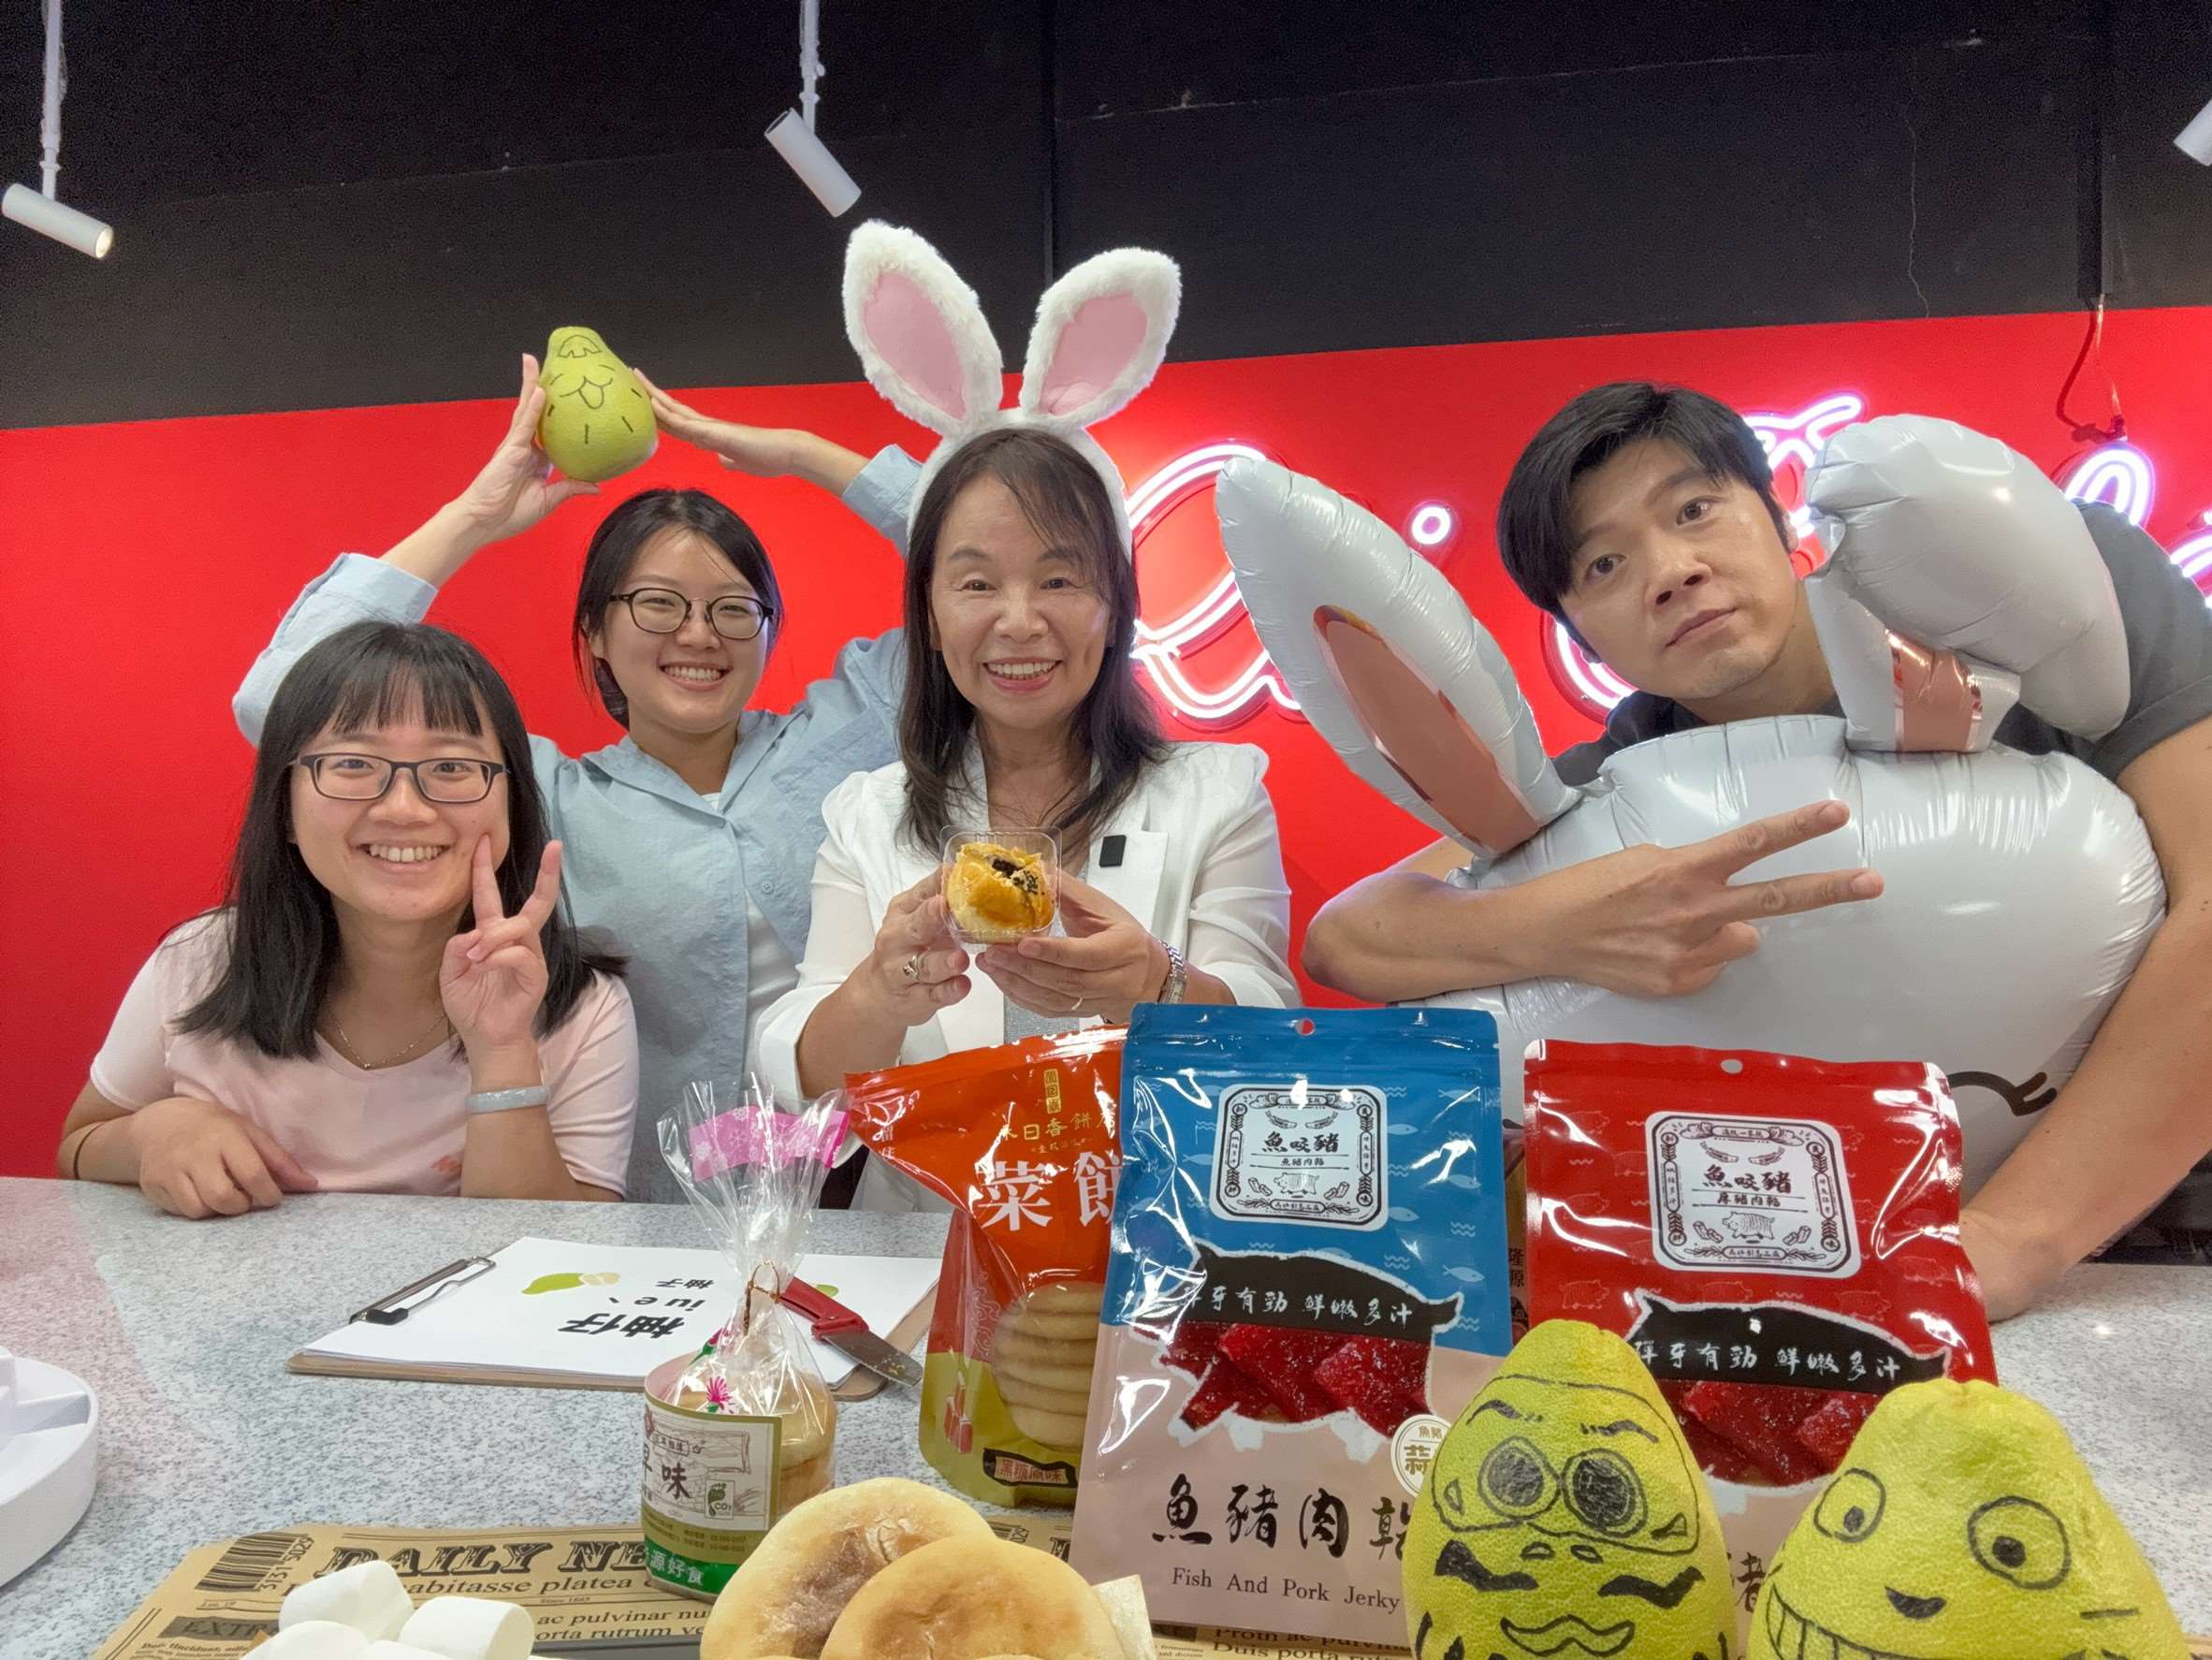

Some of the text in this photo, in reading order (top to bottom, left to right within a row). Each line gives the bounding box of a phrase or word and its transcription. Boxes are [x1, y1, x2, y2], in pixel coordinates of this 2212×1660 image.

[1261, 1130, 1340, 1153] 魚咬豬
[1702, 1164, 1791, 1194] 魚咬豬
[558, 1313, 685, 1338] 柚仔
[1404, 1444, 1431, 1476] 蒜
[313, 1541, 646, 1580] DAILY NE
[403, 1579, 530, 1594] abitasse
[540, 1578, 633, 1595] platea
[1171, 1567, 1401, 1614] Fish And Pork Jerky
[183, 1620, 278, 1638] EXTR
[537, 1610, 709, 1626] ac pulvinar nu
[536, 1630, 582, 1641] orta
[590, 1627, 671, 1638] rutrum
[1213, 1641, 1269, 1658] Duis
